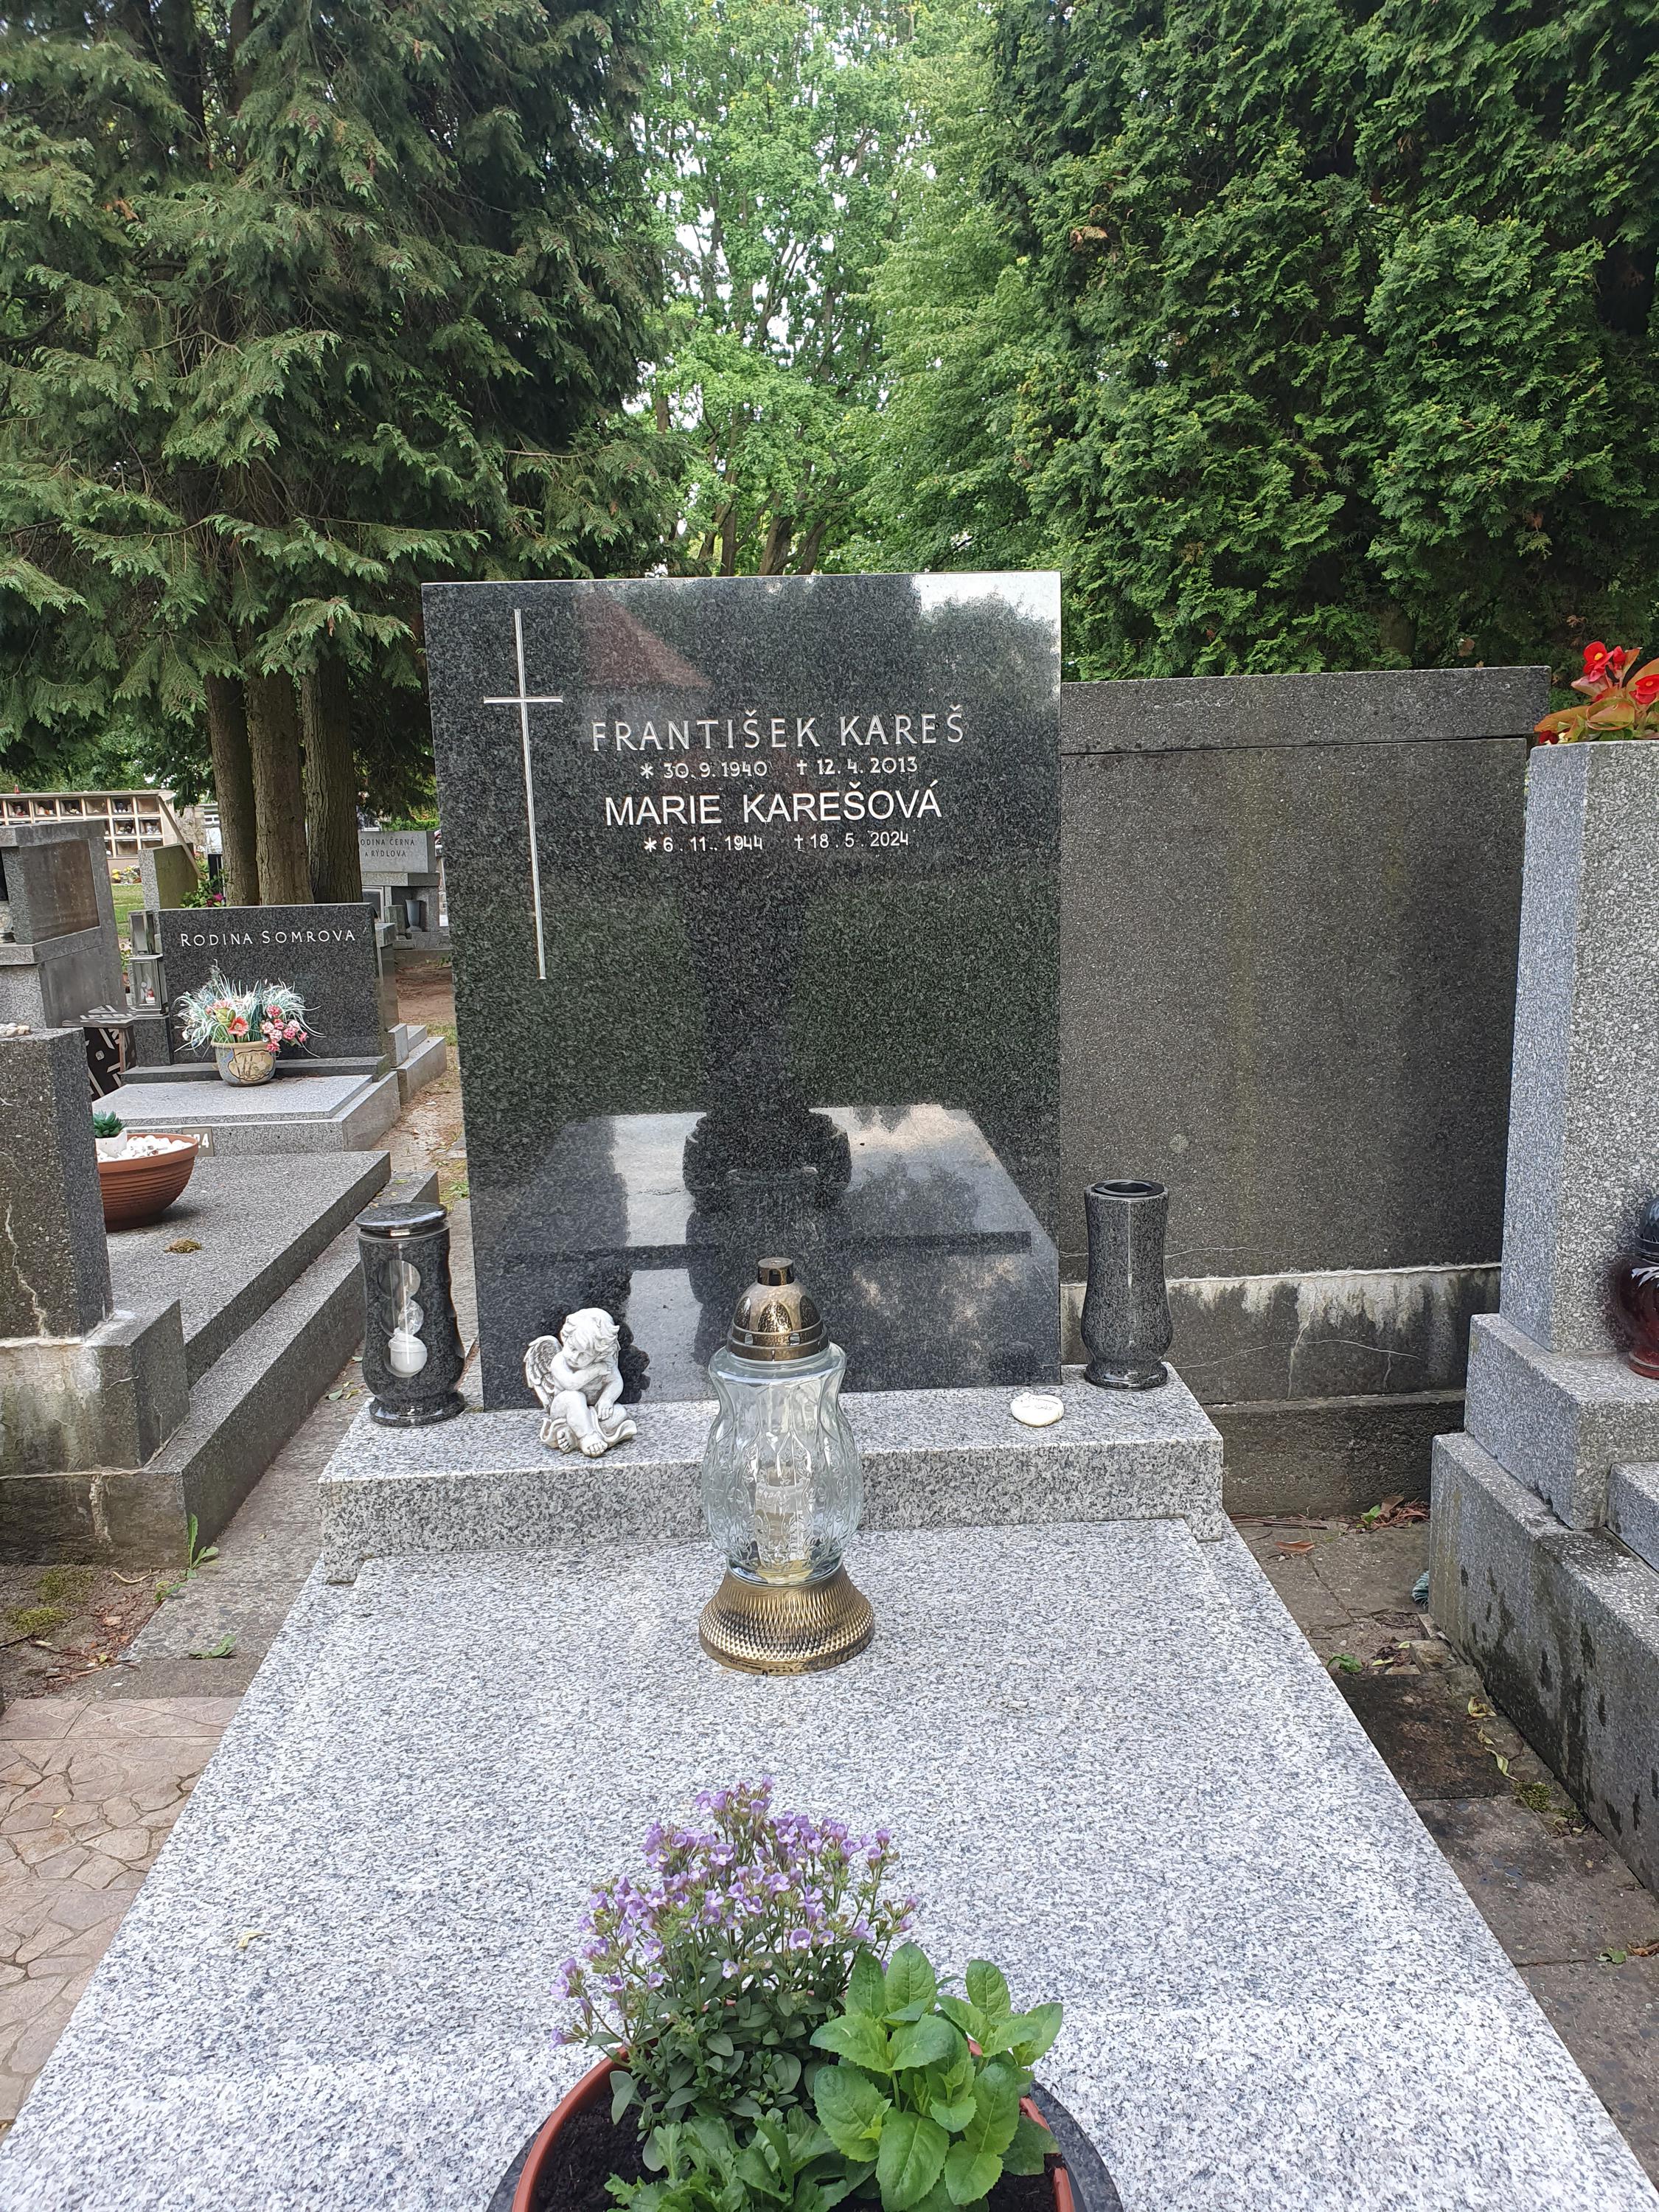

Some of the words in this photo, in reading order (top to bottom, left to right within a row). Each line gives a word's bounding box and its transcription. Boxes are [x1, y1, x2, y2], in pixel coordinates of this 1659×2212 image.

[591, 709, 819, 751] FRANTIŠEK
[839, 704, 964, 746] KAREŠ
[605, 794, 722, 826] MARIE
[743, 780, 942, 824] KAREŠOVÁ
[180, 933, 253, 947] RODINA
